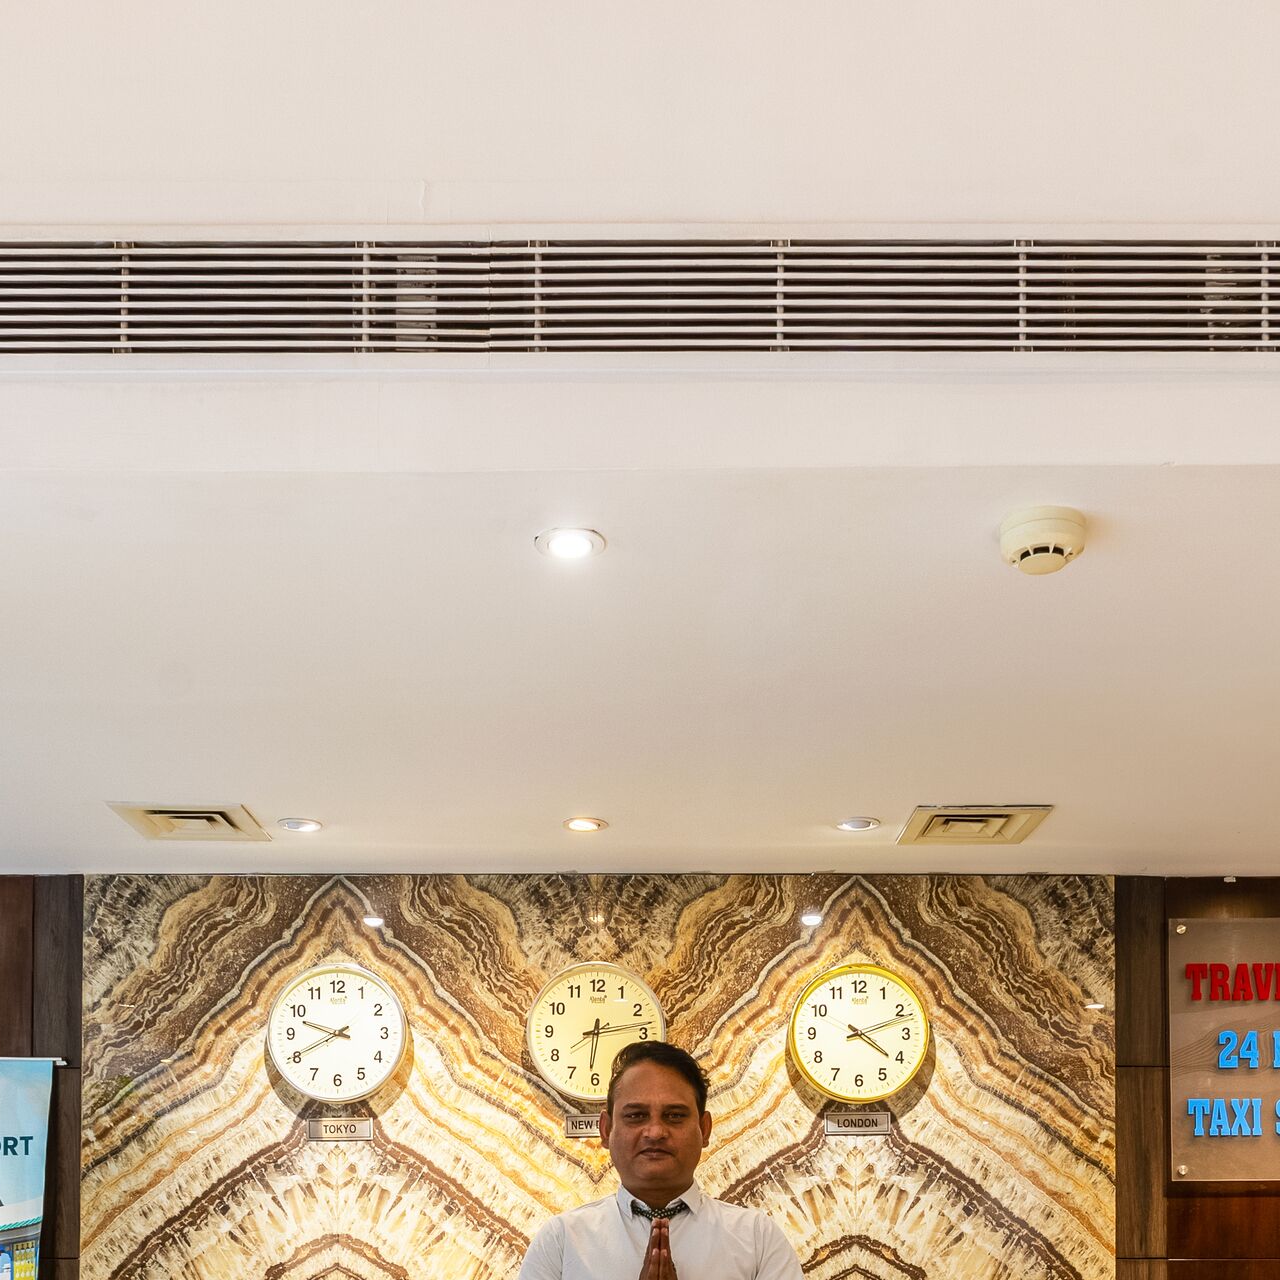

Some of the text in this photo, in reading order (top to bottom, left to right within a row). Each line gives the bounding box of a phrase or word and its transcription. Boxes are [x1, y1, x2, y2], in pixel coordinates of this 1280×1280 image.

[330, 980, 346, 994] 12
[568, 985, 581, 998] 11
[590, 979, 606, 992] 12
[851, 981, 867, 994] 12
[308, 986, 321, 1000] 11
[358, 986, 365, 1000] 1
[618, 986, 624, 999] 1
[829, 987, 842, 1000] 11
[880, 987, 886, 1000] 1
[290, 1004, 306, 1018] 10
[373, 1004, 383, 1017] 2
[549, 1002, 565, 1015] 10
[633, 1004, 642, 1017] 2
[811, 1004, 827, 1017] 10
[895, 1004, 904, 1017] 2
[286, 1027, 296, 1040] 9
[380, 1027, 389, 1040] 3
[545, 1025, 554, 1038] 9
[639, 1027, 648, 1040] 3
[808, 1027, 817, 1040] 9
[902, 1027, 911, 1040] 3
[551, 1049, 560, 1062] 8
[1218, 1030, 1259, 1068] 24
[292, 1051, 302, 1064] 8
[373, 1050, 383, 1063] 4
[814, 1051, 823, 1064] 8
[895, 1051, 904, 1064] 4
[309, 1068, 319, 1081] 7
[357, 1067, 366, 1080] 5
[567, 1066, 577, 1079] 7
[831, 1068, 840, 1081] 7
[878, 1068, 887, 1081] 5
[333, 1074, 342, 1087] 6
[591, 1073, 600, 1086] 6
[854, 1074, 864, 1087] 6
[837, 1118, 878, 1128] LONDON
[1187, 1098, 1262, 1136] TAXI
[323, 1124, 357, 1134] TOKYO
[571, 1121, 593, 1130] NEW
